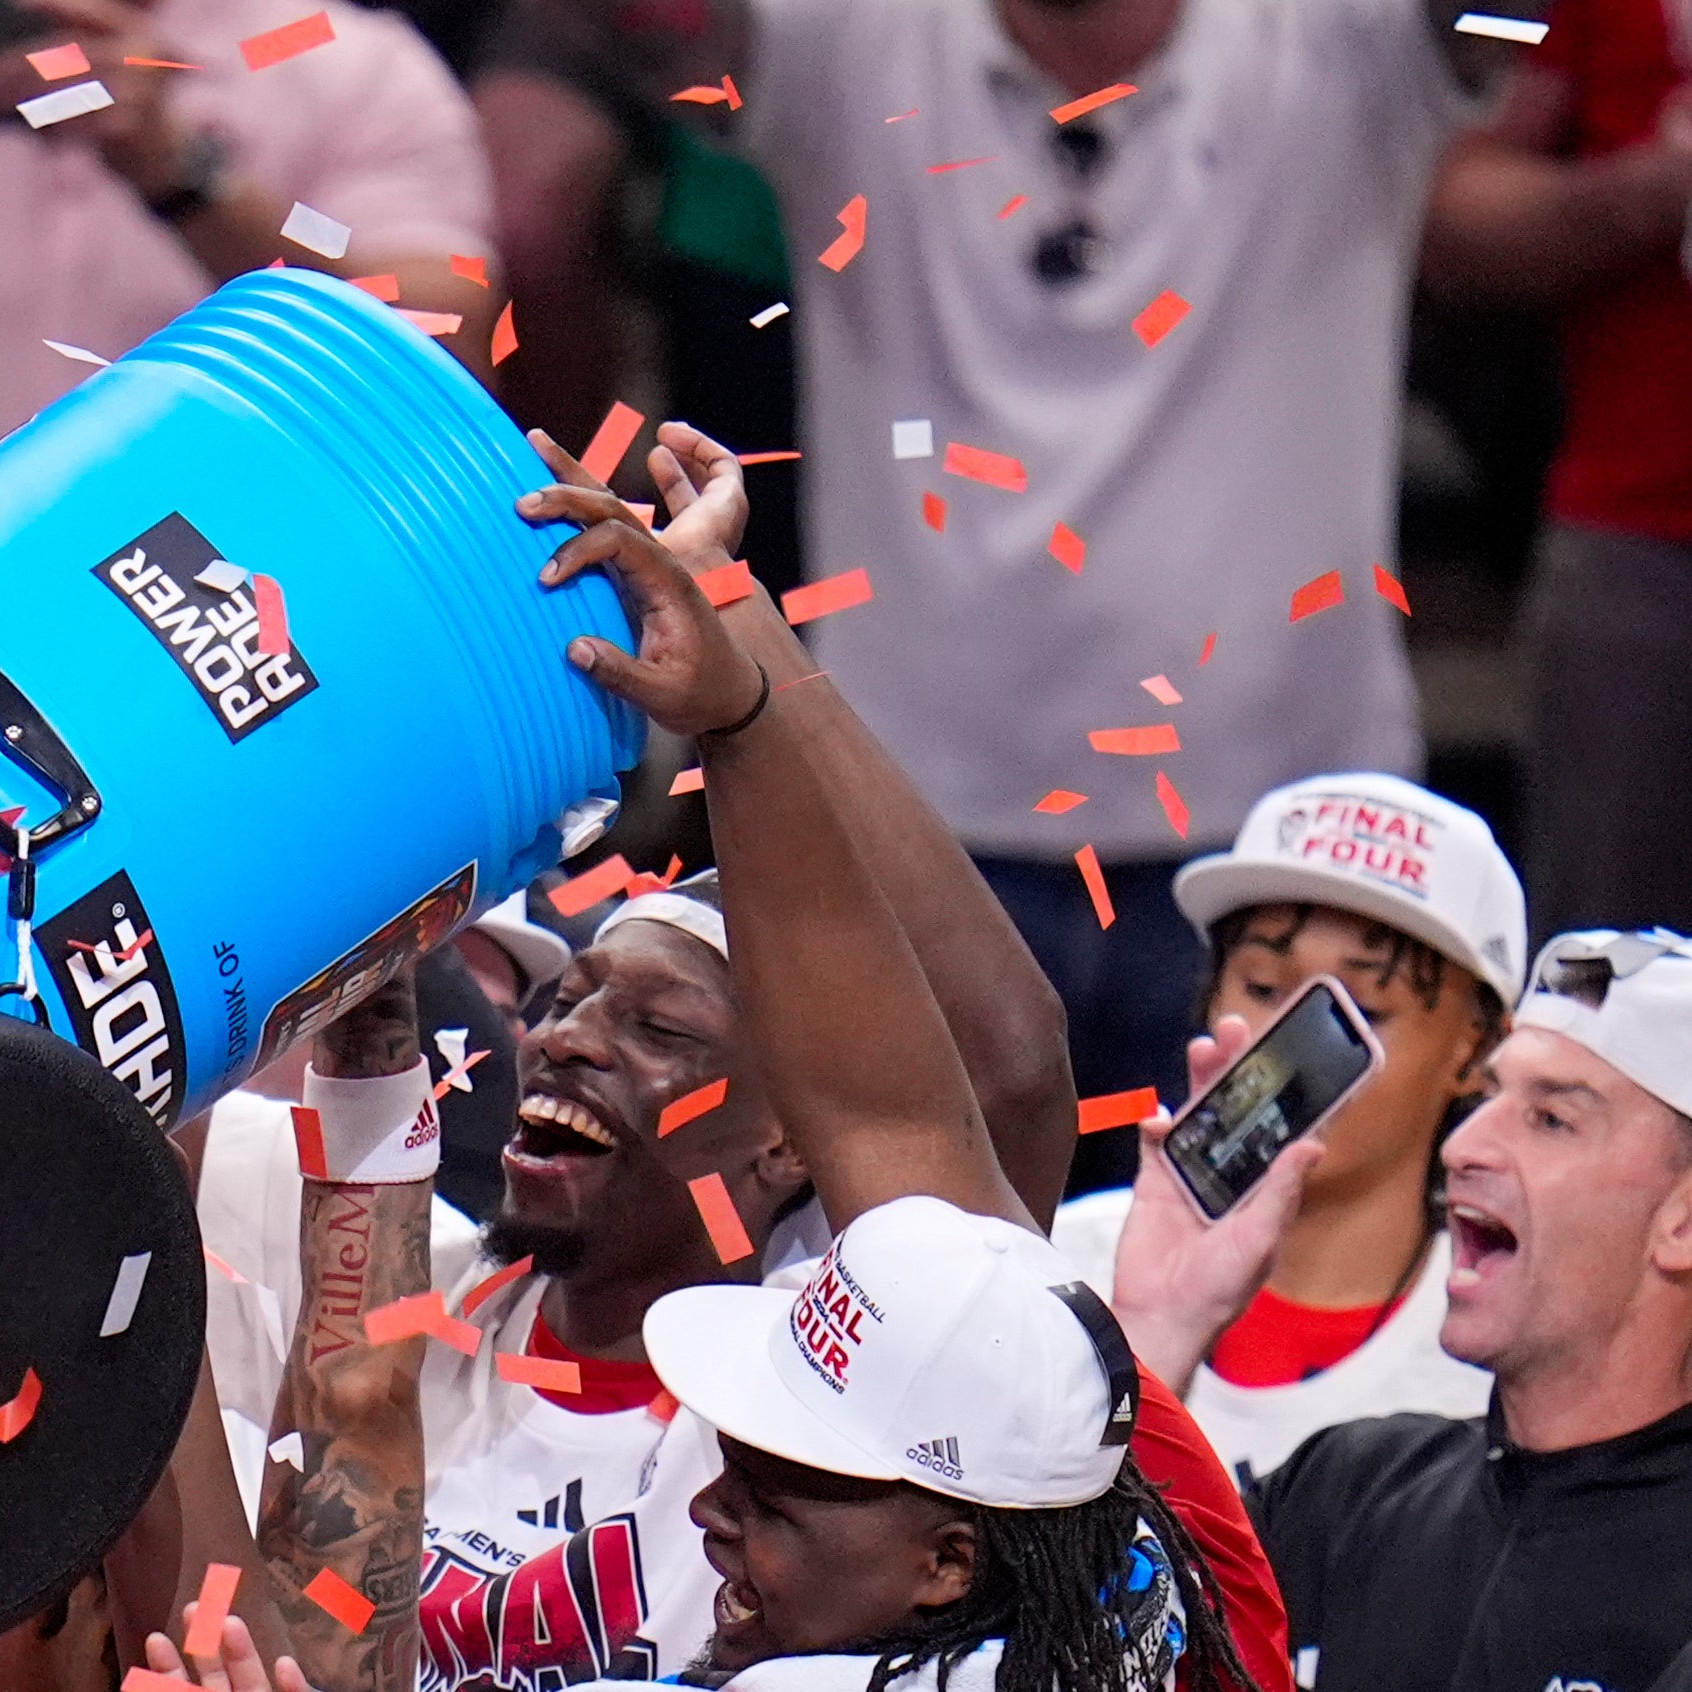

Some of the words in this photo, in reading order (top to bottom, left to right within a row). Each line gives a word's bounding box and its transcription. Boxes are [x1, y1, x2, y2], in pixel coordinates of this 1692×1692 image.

[109, 547, 270, 730] POWER
[1314, 803, 1436, 852] FINAL
[1302, 838, 1426, 884] FOUR
[213, 940, 242, 977] OF
[224, 977, 250, 1055] DRINK
[404, 1123, 440, 1151] adidas
[309, 1184, 376, 1366] VilleM
[905, 1446, 965, 1481] adidas
